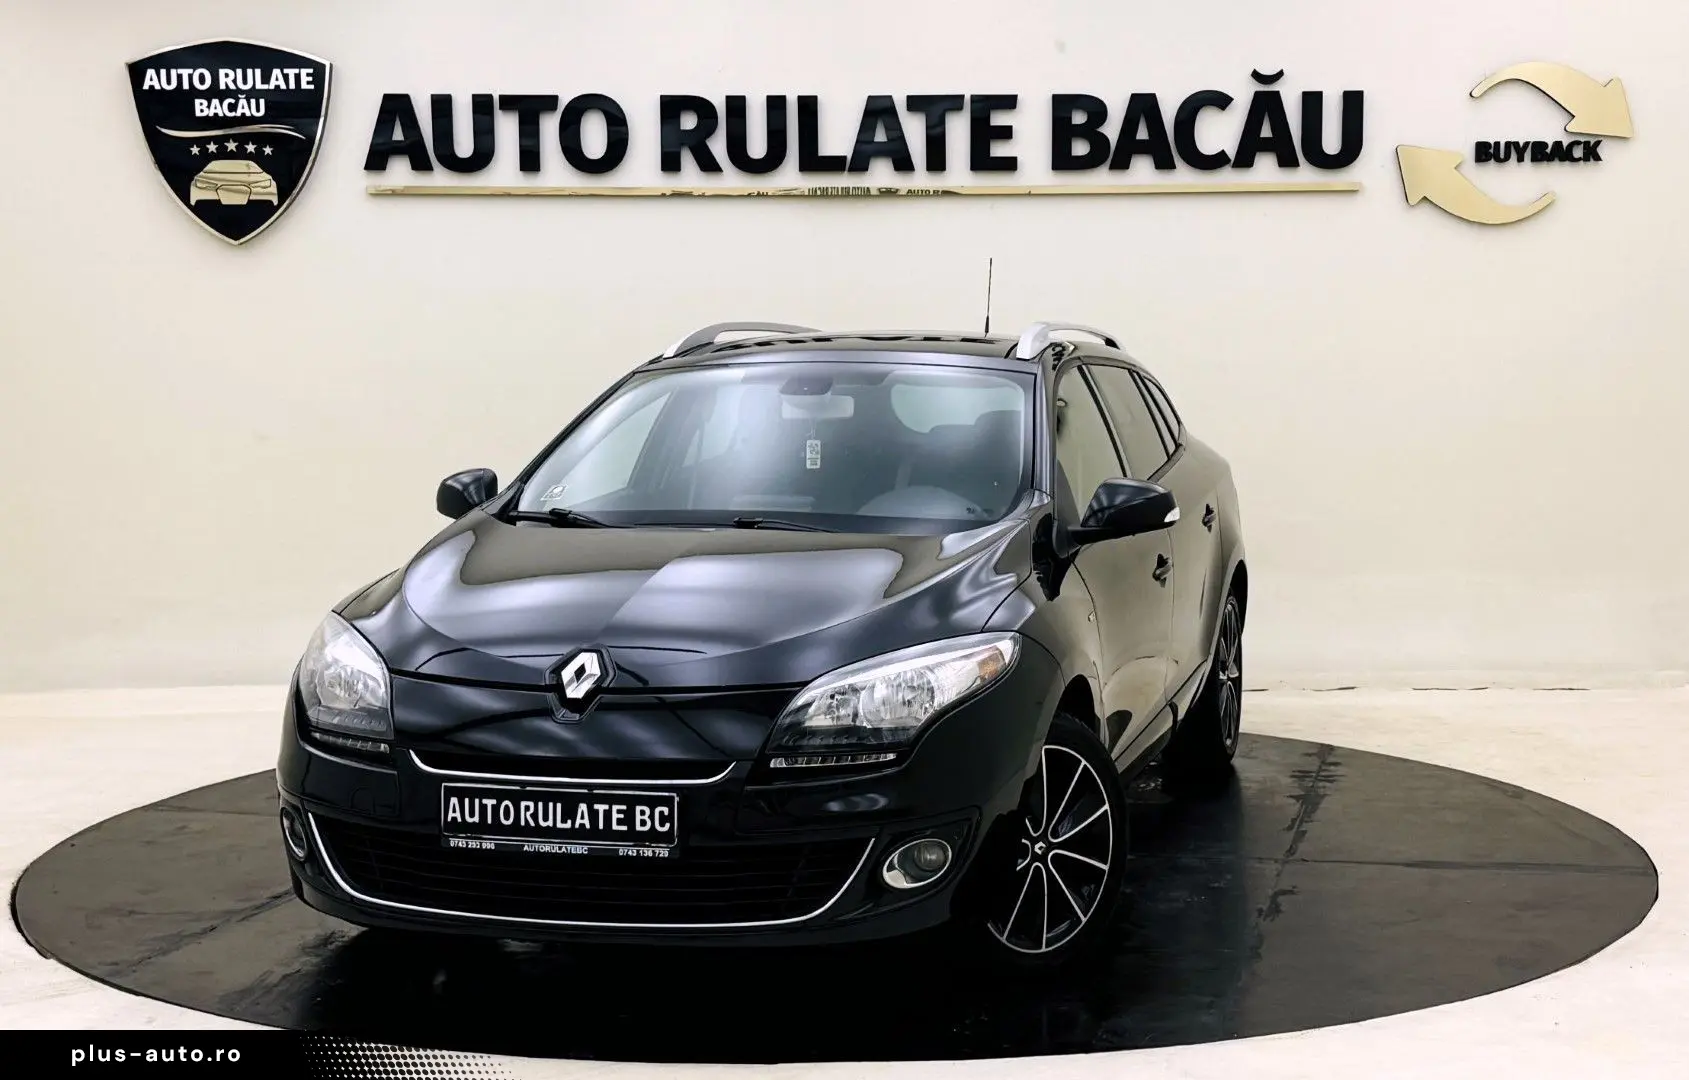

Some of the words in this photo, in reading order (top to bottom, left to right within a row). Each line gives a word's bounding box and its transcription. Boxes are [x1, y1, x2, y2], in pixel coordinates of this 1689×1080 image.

[142, 68, 212, 91] AUTO
[218, 68, 315, 90] RULATE
[194, 94, 266, 117] BACĂU
[364, 93, 630, 174] AUTO
[659, 94, 1019, 174] RULATE
[1051, 68, 1364, 171] BACĂU
[1474, 139, 1603, 163] BUYBACK
[635, 805, 671, 832] BC
[618, 848, 637, 857] 0743
